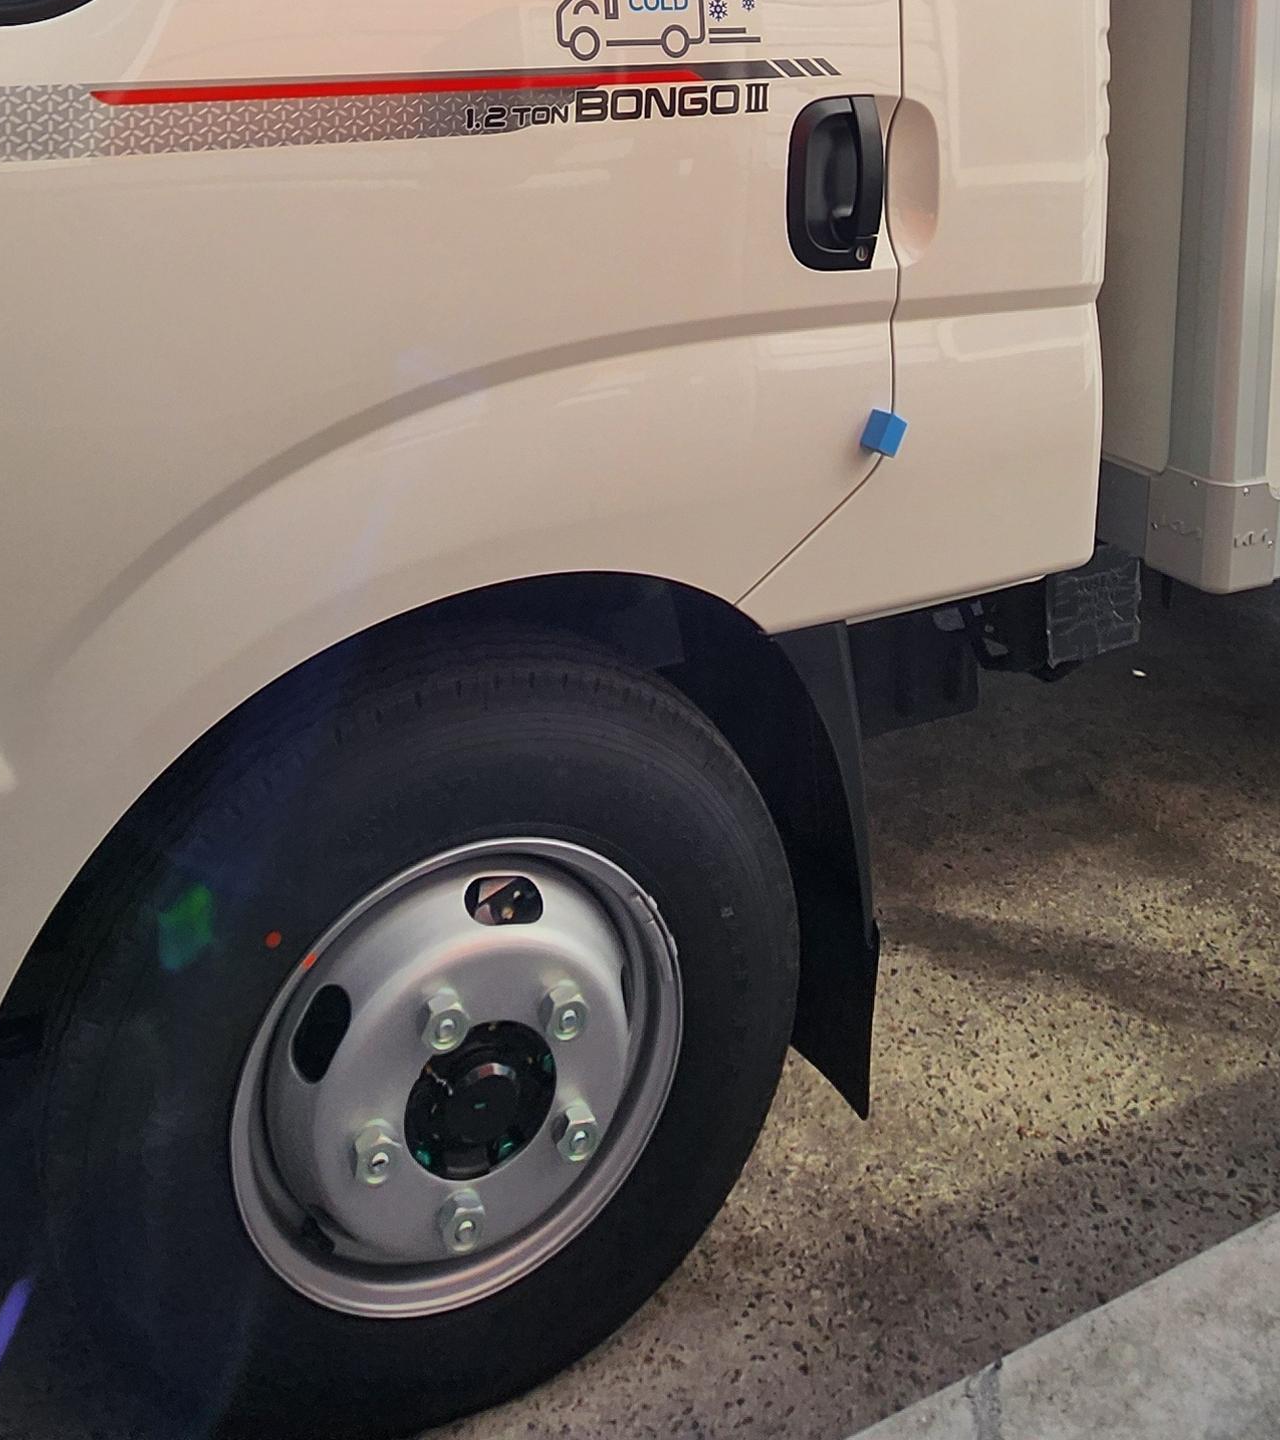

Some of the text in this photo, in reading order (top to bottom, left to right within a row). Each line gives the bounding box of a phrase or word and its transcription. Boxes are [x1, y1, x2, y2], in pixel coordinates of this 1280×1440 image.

[465, 106, 508, 130] 1.2
[511, 105, 569, 127] TON
[575, 85, 740, 123] BONGO
